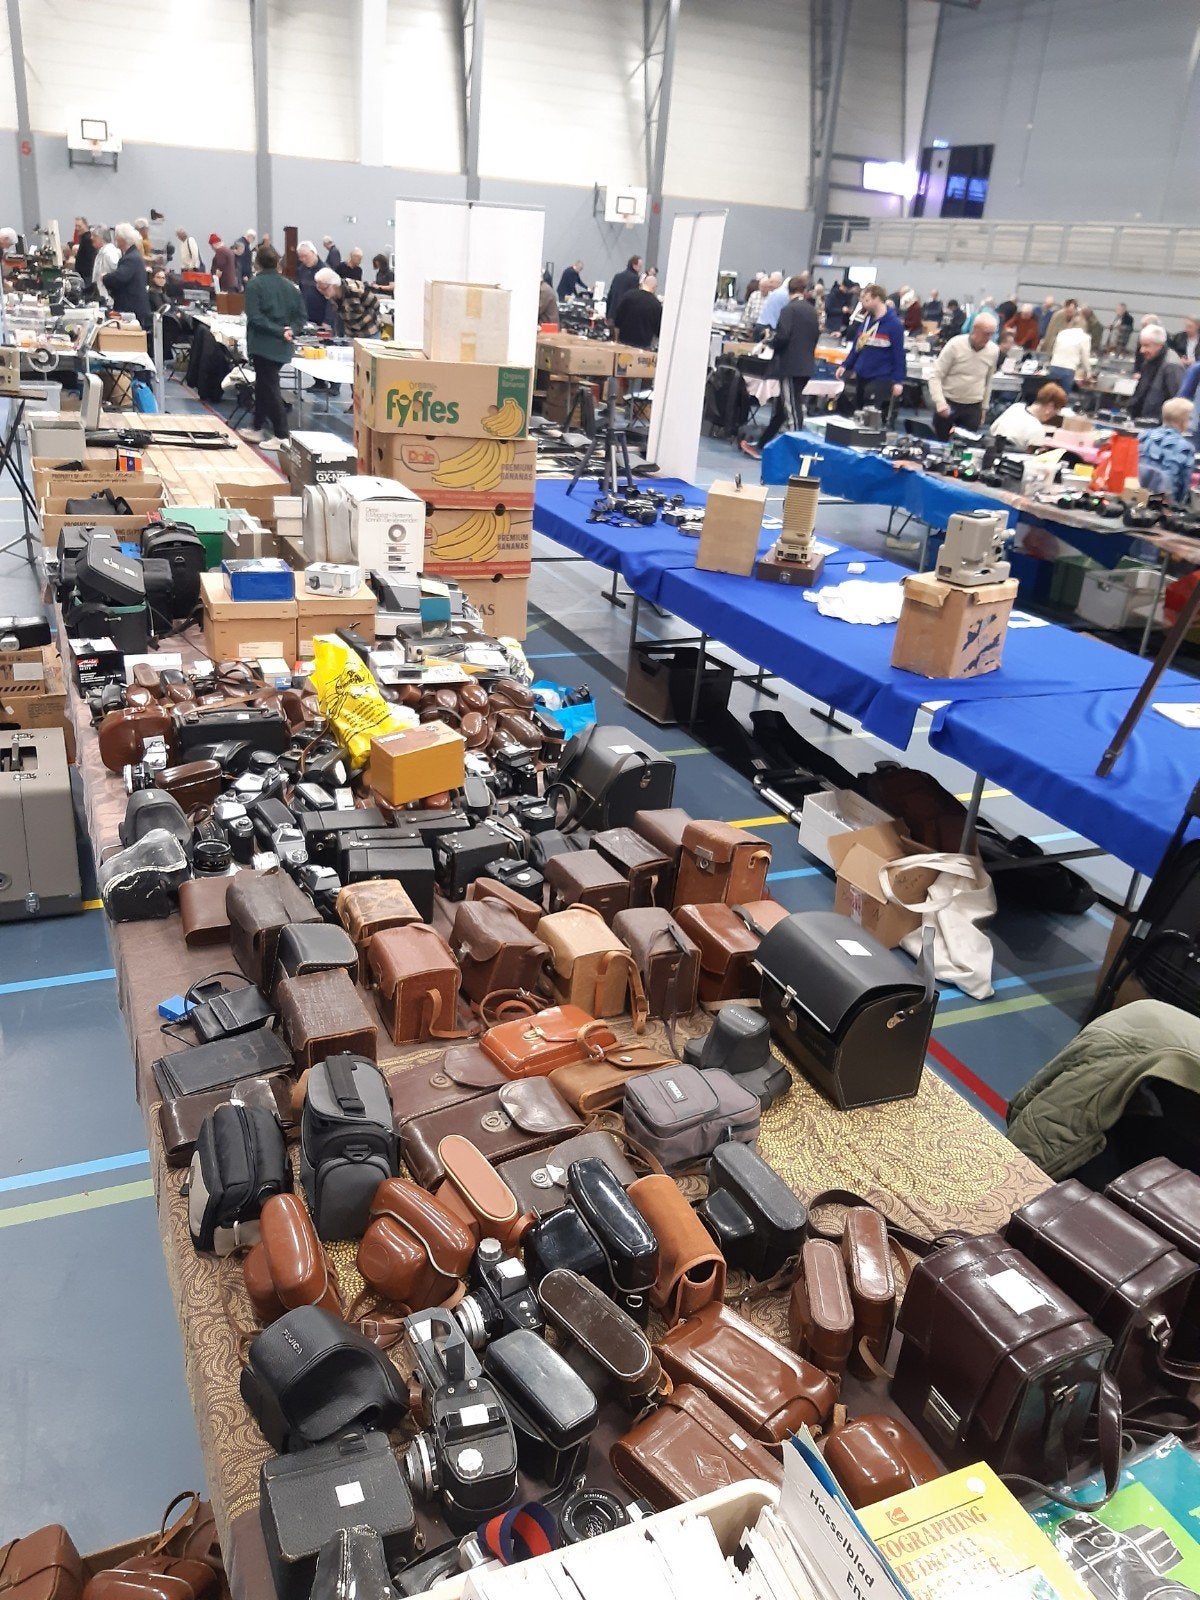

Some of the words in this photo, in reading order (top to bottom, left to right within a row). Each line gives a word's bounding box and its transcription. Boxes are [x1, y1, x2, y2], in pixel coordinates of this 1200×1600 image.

[408, 450, 434, 462] Dole
[501, 464, 533, 472] PREMIUM
[501, 473, 533, 481] BANANAS
[497, 533, 528, 541] PREMIUM
[497, 542, 529, 550] BANANAS
[809, 1489, 875, 1588] Hasselblad
